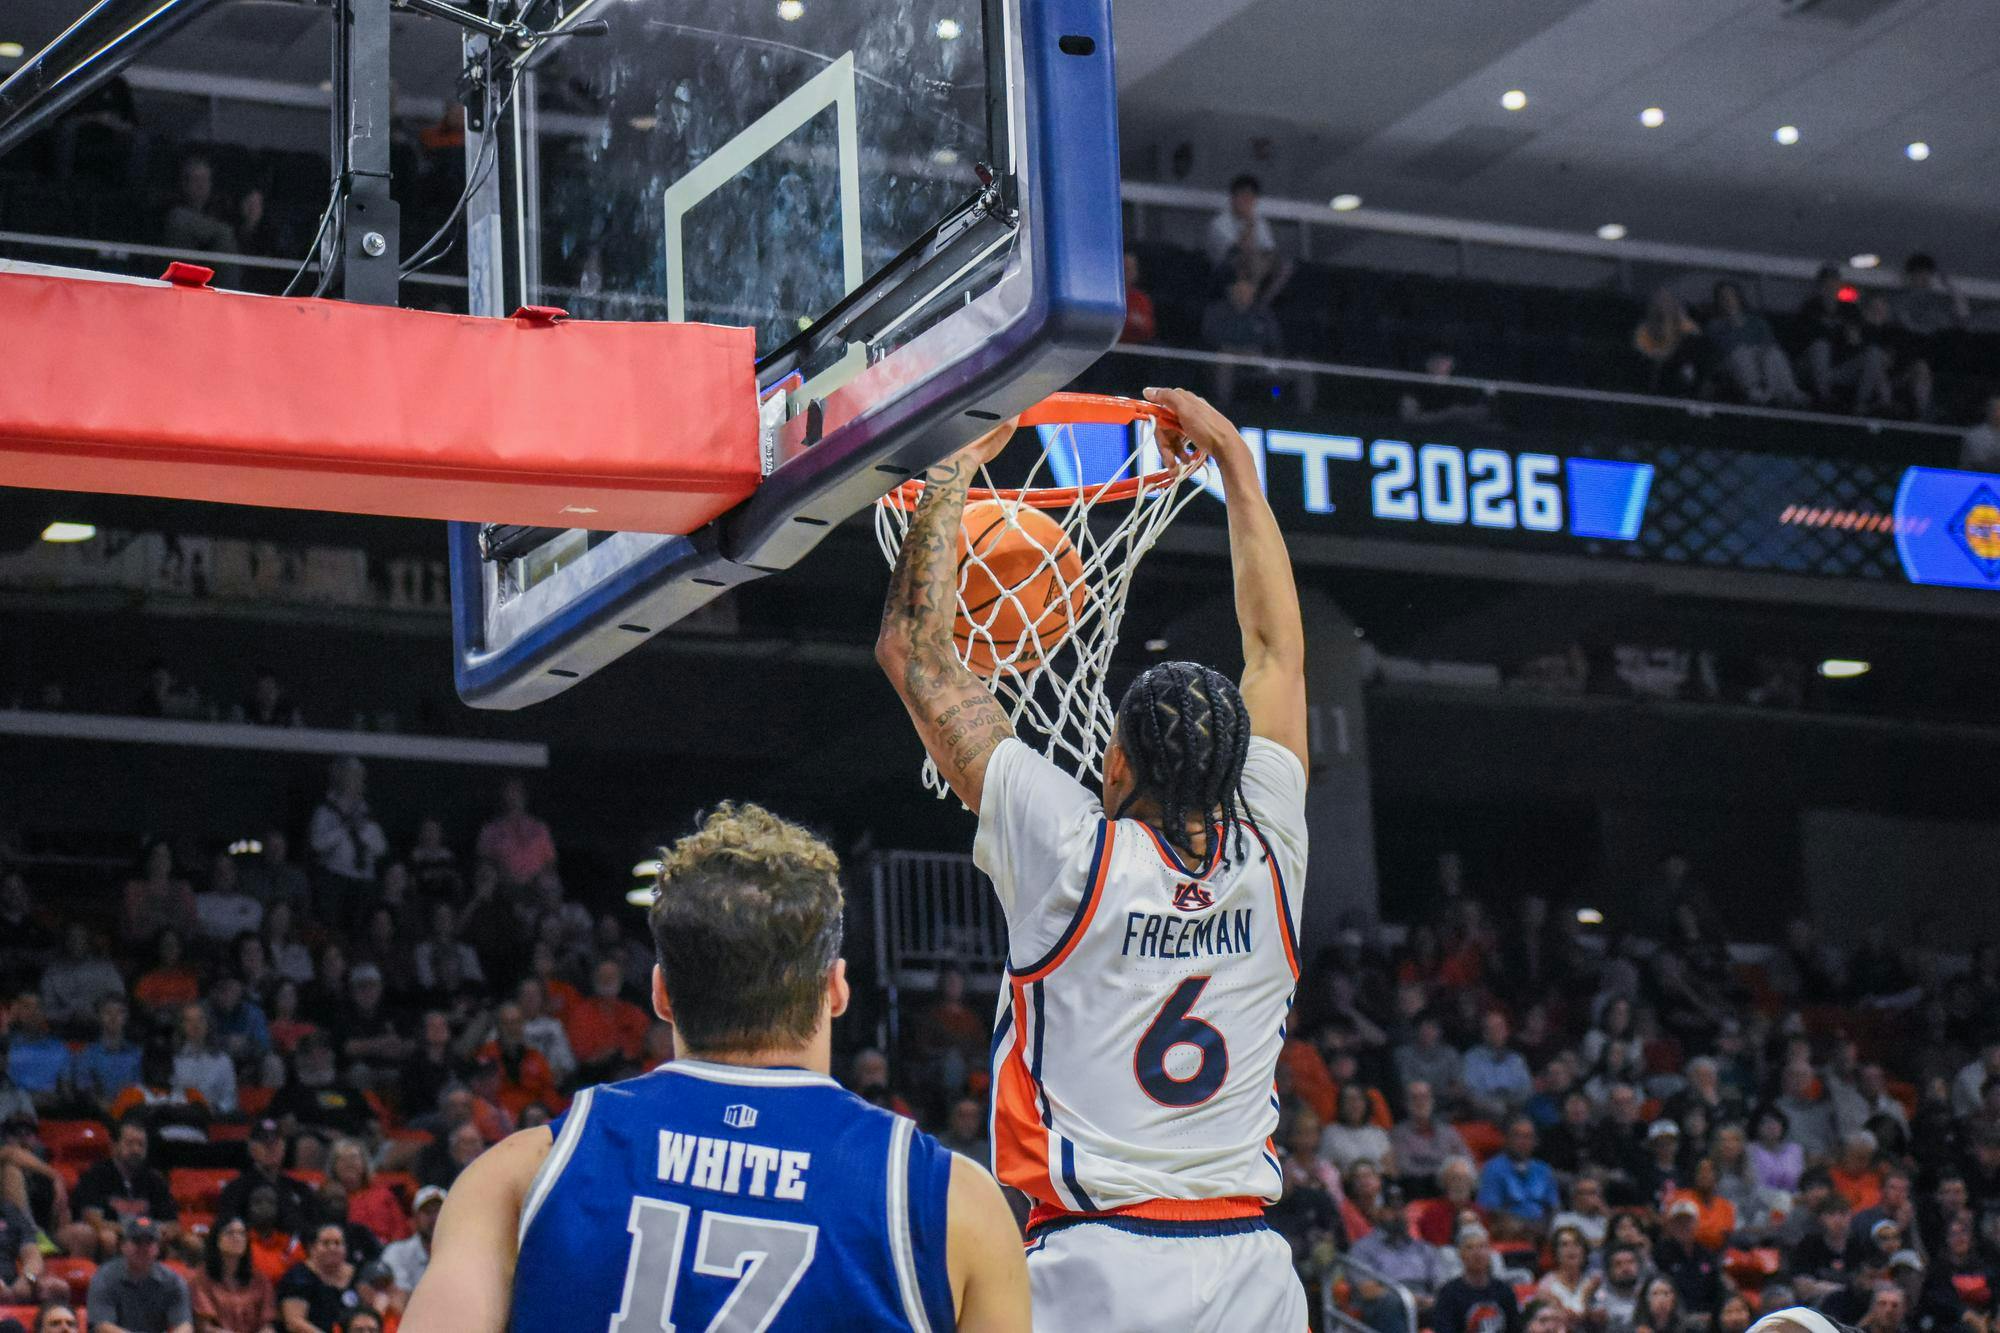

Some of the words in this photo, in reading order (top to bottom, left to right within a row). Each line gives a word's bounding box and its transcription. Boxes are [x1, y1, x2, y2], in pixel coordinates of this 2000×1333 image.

[1369, 438, 1564, 532] 2026
[1122, 909, 1252, 959] FREEMAN
[1134, 976, 1229, 1108] 6
[657, 1129, 811, 1200] WHITE
[608, 1195, 819, 1333] 17
